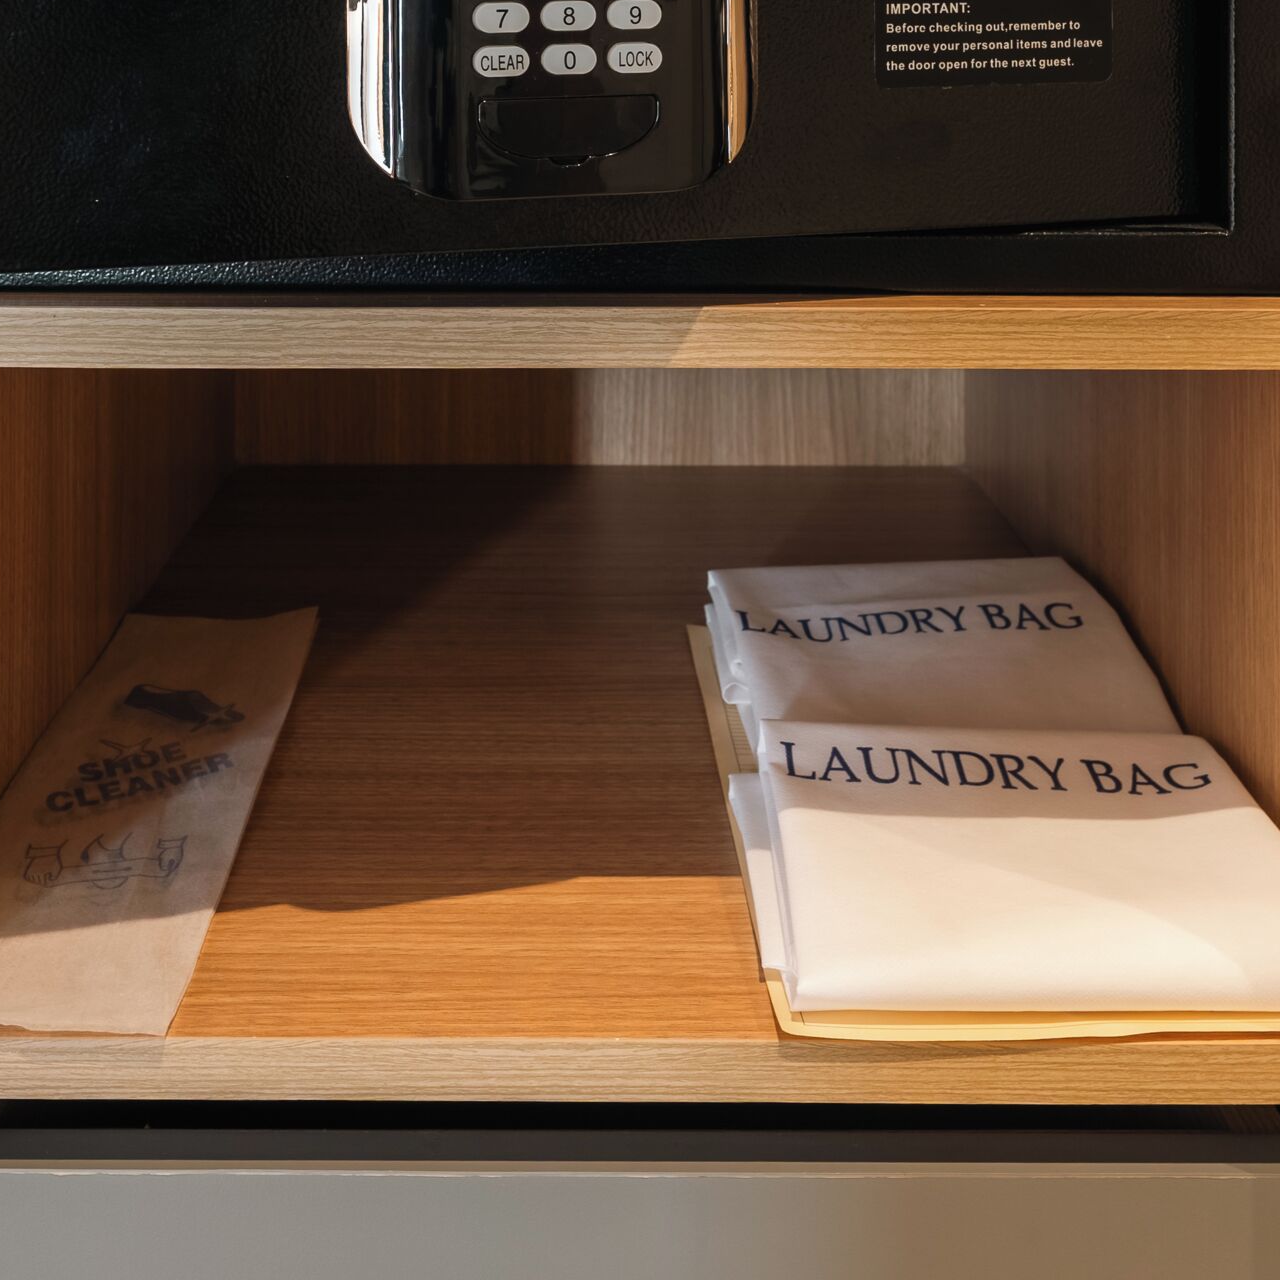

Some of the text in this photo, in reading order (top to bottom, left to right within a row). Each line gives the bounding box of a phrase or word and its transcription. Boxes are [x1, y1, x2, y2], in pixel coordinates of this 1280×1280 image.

[562, 7, 576, 27] 8
[628, 6, 642, 25] 9
[886, 2, 971, 15] IMPORTANT:
[495, 9, 509, 28] 7
[929, 22, 983, 34] checking
[985, 20, 1067, 33] out,remember
[1069, 20, 1081, 31] to
[886, 38, 1103, 54] remove your personal items and leave
[480, 54, 525, 72] CLEAR
[563, 51, 577, 71] 0
[618, 50, 654, 68] LOCK
[886, 56, 1075, 72] the door open for the next guest.
[735, 601, 1084, 644] LAUNDRY BAG
[78, 742, 186, 782] SHOE
[780, 741, 1212, 796] LAUNDRY BAG
[46, 752, 234, 812] CLEANER
